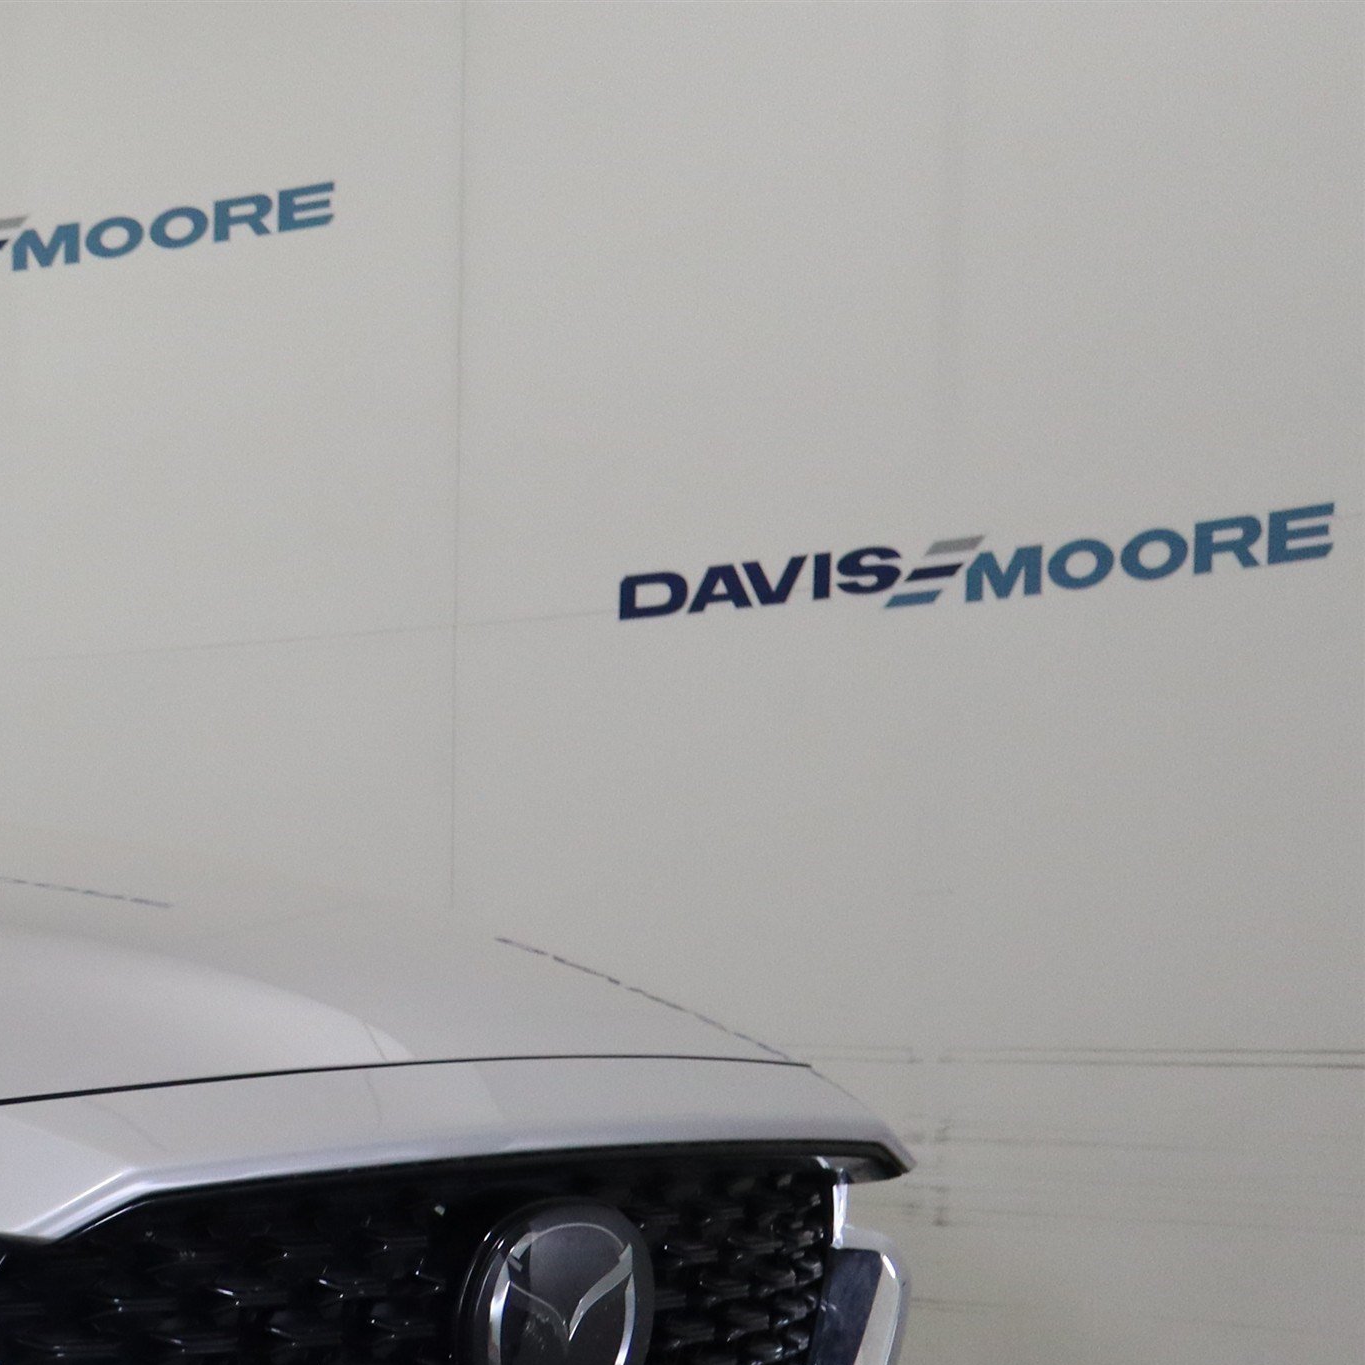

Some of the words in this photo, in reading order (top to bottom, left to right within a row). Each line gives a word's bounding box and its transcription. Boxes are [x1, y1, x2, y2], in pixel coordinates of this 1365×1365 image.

[12, 181, 334, 271] MOORE
[619, 546, 904, 620] DAVIS
[966, 503, 1335, 603] MOORE
